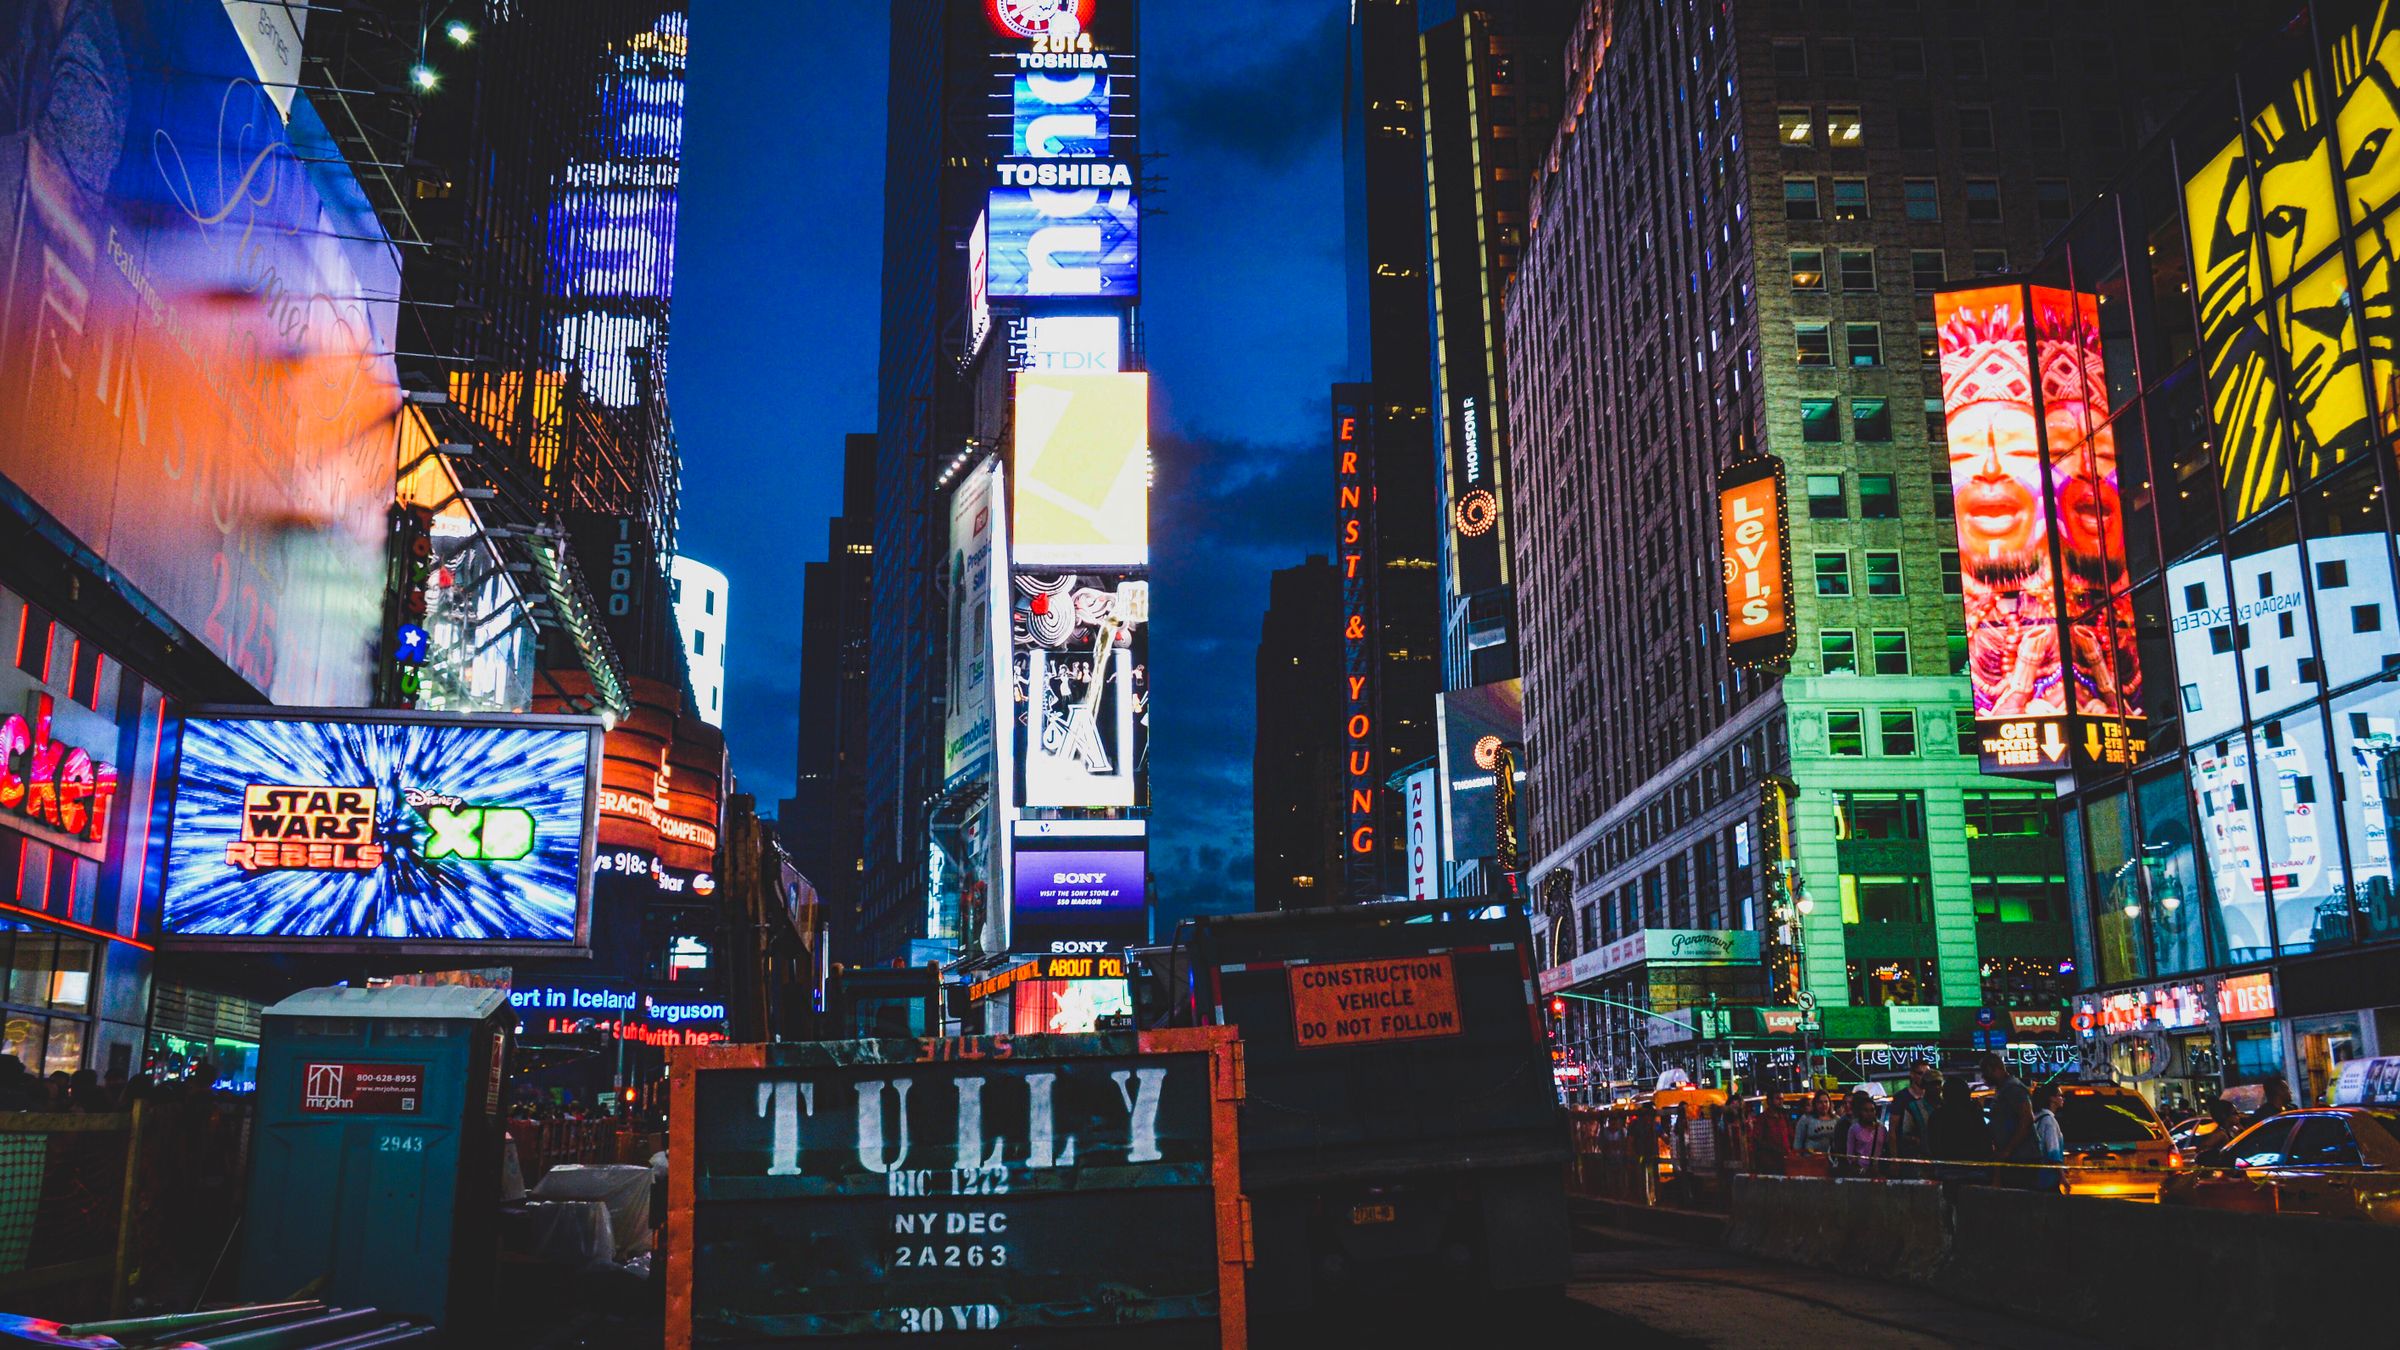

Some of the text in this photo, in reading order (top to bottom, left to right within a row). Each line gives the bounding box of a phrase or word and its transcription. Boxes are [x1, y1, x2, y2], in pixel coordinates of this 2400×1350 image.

[258, 7, 288, 67] games
[1032, 33, 1092, 53] 2014
[1016, 52, 1108, 69] TOSHIBA
[996, 163, 1132, 187] TOSHIBA
[1037, 351, 1107, 369] TDK
[1463, 408, 1480, 483] THOMSON
[607, 518, 632, 617] 1500
[1732, 495, 1772, 627] Levi's
[1340, 417, 1374, 853] ERNST & YOUNG
[2000, 722, 2037, 739] GET
[1982, 738, 2039, 753] TICKETS
[1998, 750, 2039, 765] HERE
[249, 790, 370, 815] STAR
[404, 786, 464, 812] Disney
[249, 815, 369, 840] WARS
[425, 806, 536, 861] XD
[1411, 781, 1425, 900] RICOH
[225, 841, 383, 870] REBELS
[1053, 872, 1107, 884] SONY
[1070, 898, 1103, 906] MADISON
[1110, 889, 1120, 897] AT
[1051, 941, 1108, 953] SONY
[1671, 933, 1735, 957] Paramount
[1048, 958, 1125, 977] ABOUT POL
[1302, 962, 1442, 990] CONSTRUCTION
[546, 987, 566, 1008] in
[572, 988, 636, 1011] Iceland
[1337, 988, 1415, 1012] VEHICLE
[1302, 1011, 1453, 1040] DO NOT FOLLOW
[2014, 1015, 2058, 1027] Levi's
[646, 1025, 681, 1046] with
[1855, 1044, 1941, 1066] Levi's
[356, 1074, 417, 1083] 800-628-8955
[356, 1086, 416, 1094] www.mrjohn.com
[306, 1097, 354, 1111] mr.john
[757, 1068, 1168, 1177] TULLY
[380, 1135, 423, 1153] 2943
[950, 1167, 1010, 1196] 1272
[895, 1212, 1008, 1235] NY DEC
[895, 1244, 1008, 1267] 2A263
[900, 1303, 1000, 1333] 30 YD
